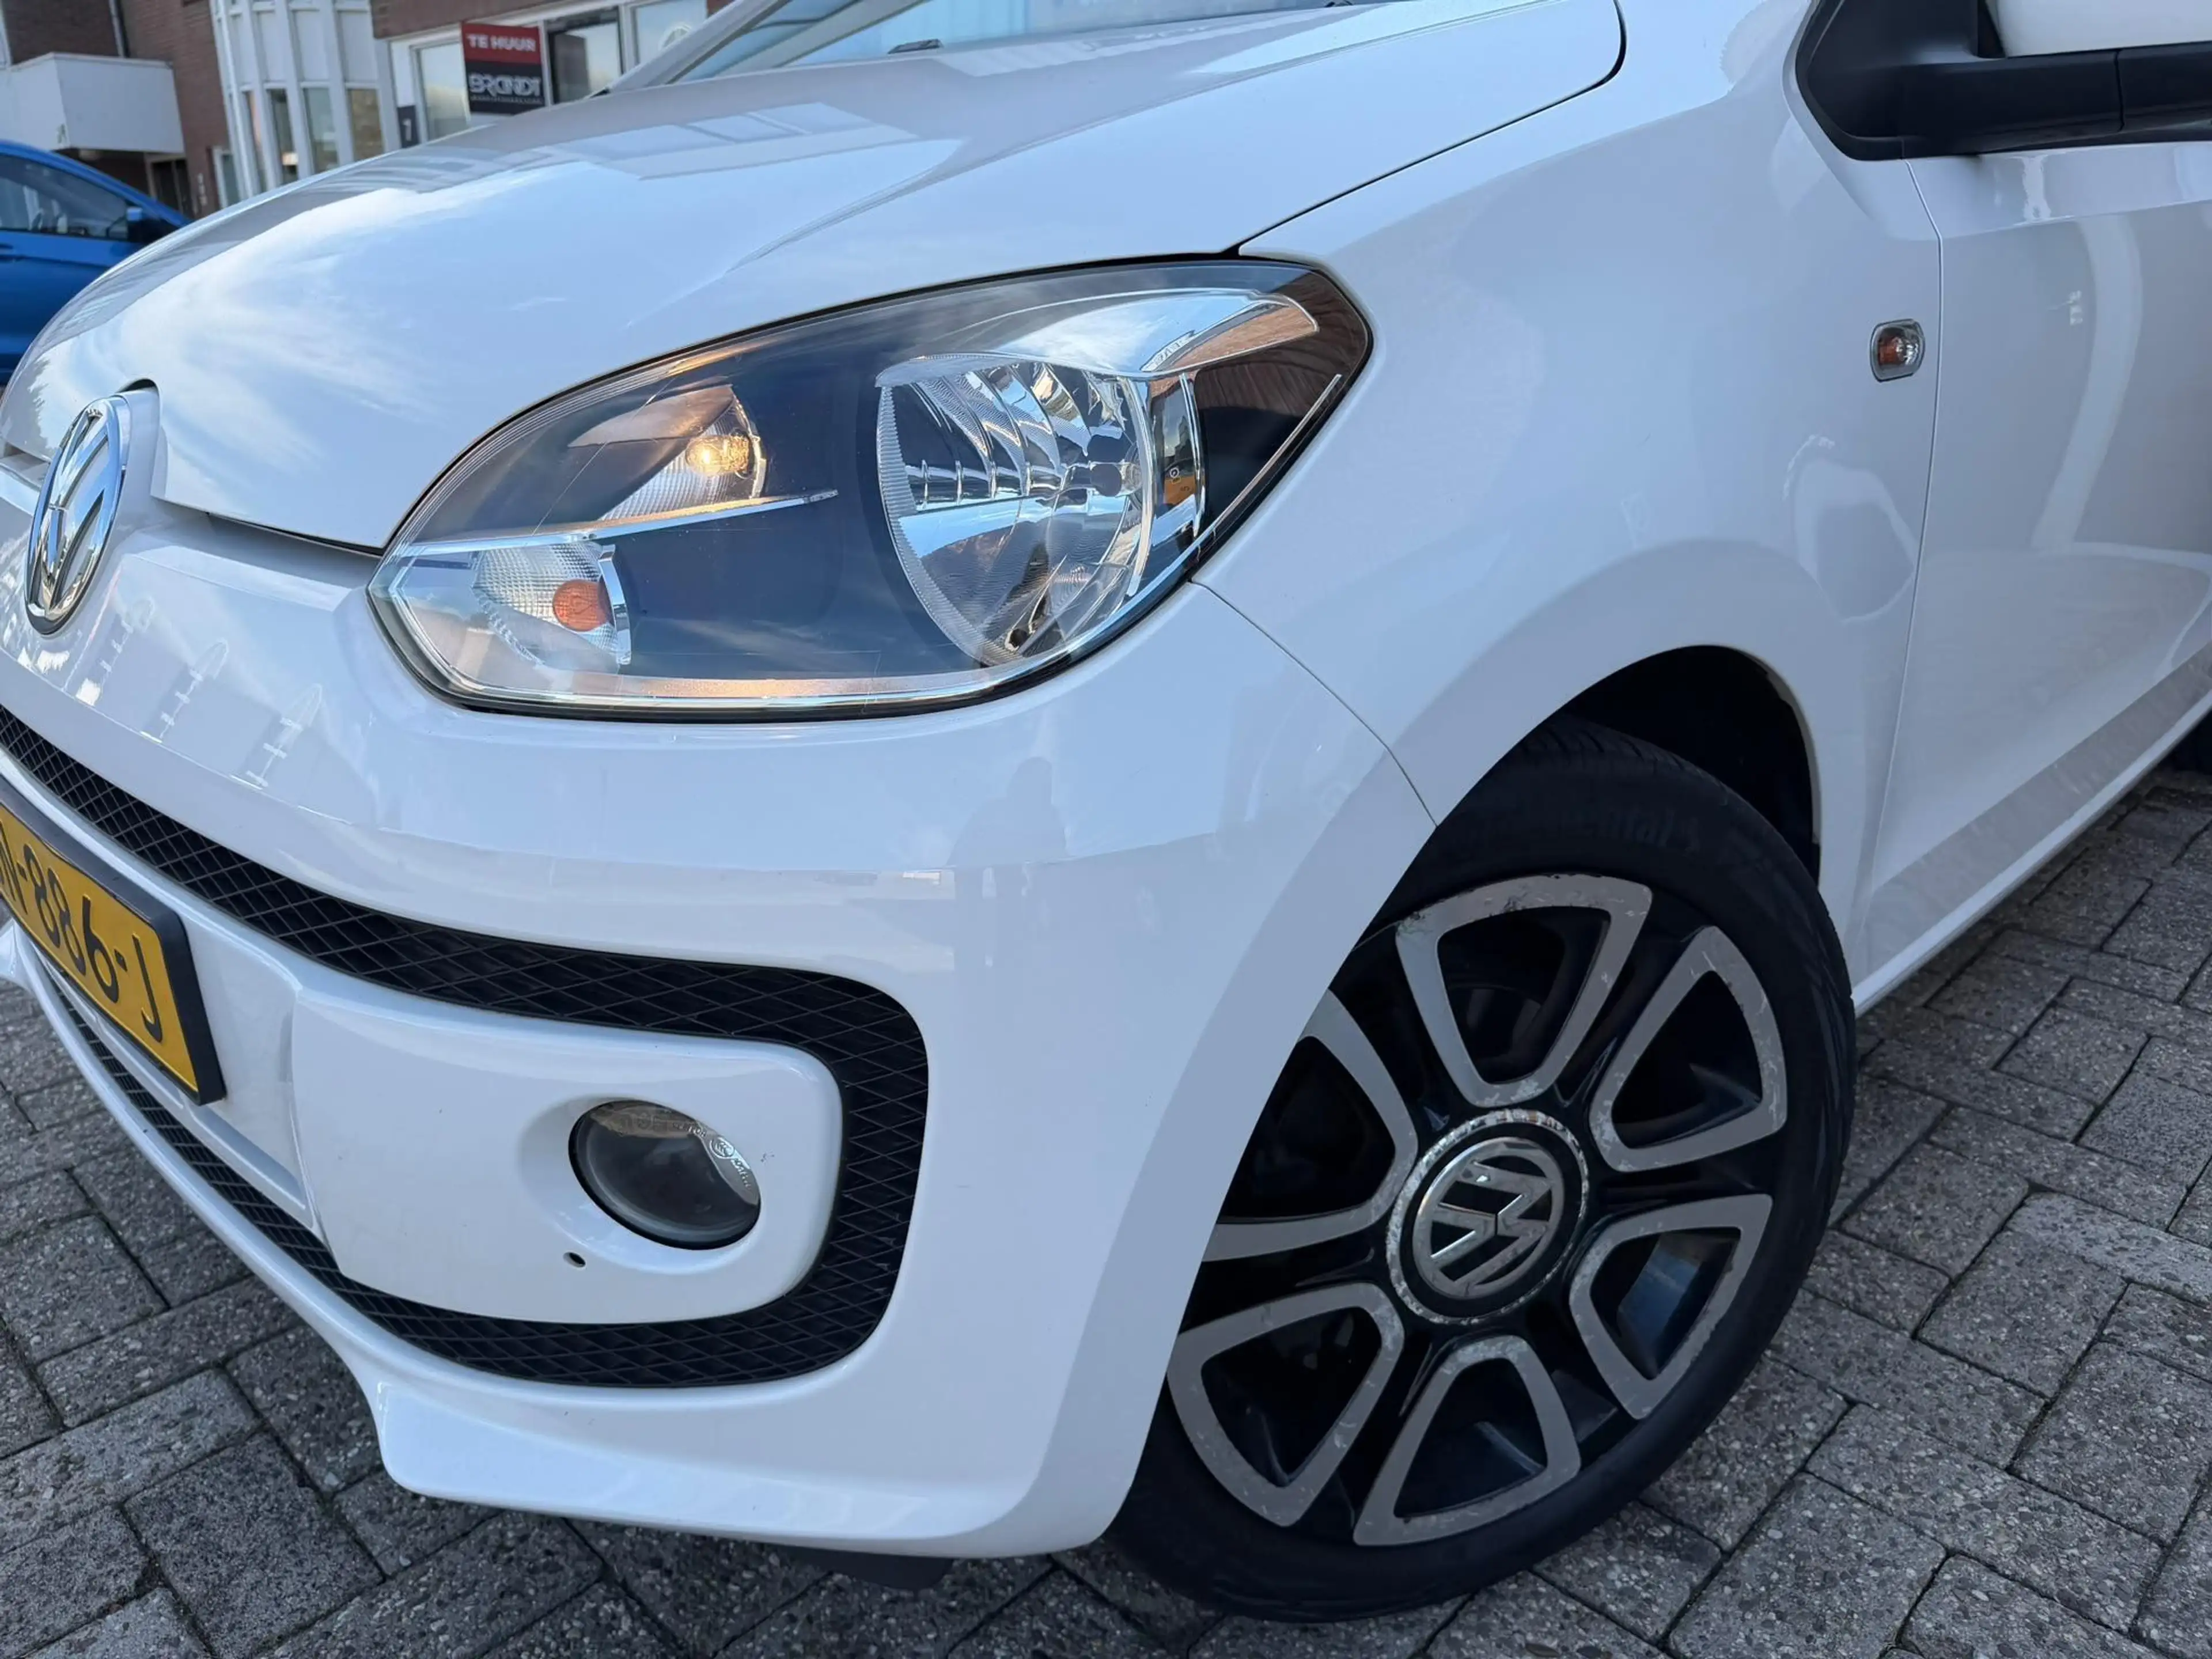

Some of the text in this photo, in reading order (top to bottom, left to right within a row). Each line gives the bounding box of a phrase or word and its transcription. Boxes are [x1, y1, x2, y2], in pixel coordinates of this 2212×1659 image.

[466, 34, 536, 52] TE HUUR
[0, 817, 163, 1043] N-886-J
